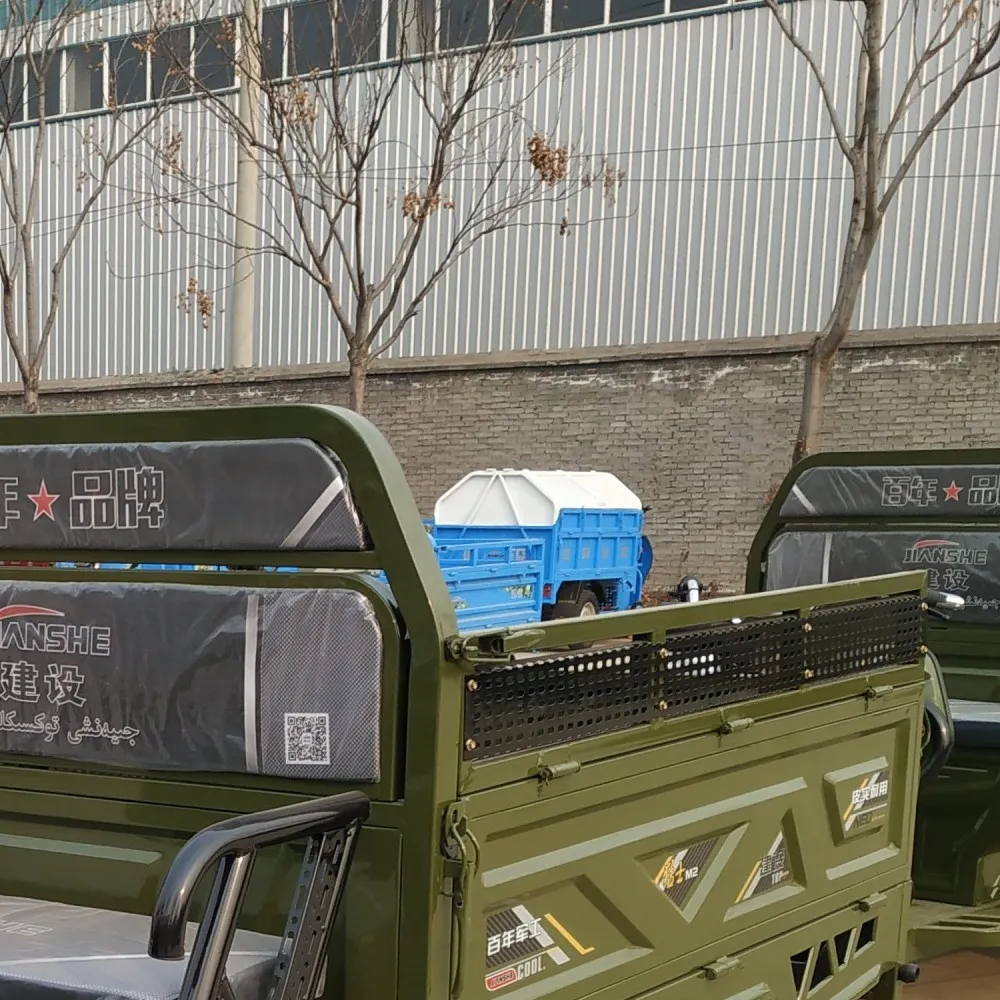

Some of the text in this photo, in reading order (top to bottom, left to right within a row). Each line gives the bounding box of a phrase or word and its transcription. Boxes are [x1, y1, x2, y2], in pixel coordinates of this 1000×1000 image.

[70, 466, 165, 529] 品牌
[881, 474, 1000, 507] 百年 品
[903, 548, 988, 565] JIANSHE
[0, 660, 87, 707] 建设
[685, 866, 699, 880] M2
[487, 918, 542, 956] 百年军工
